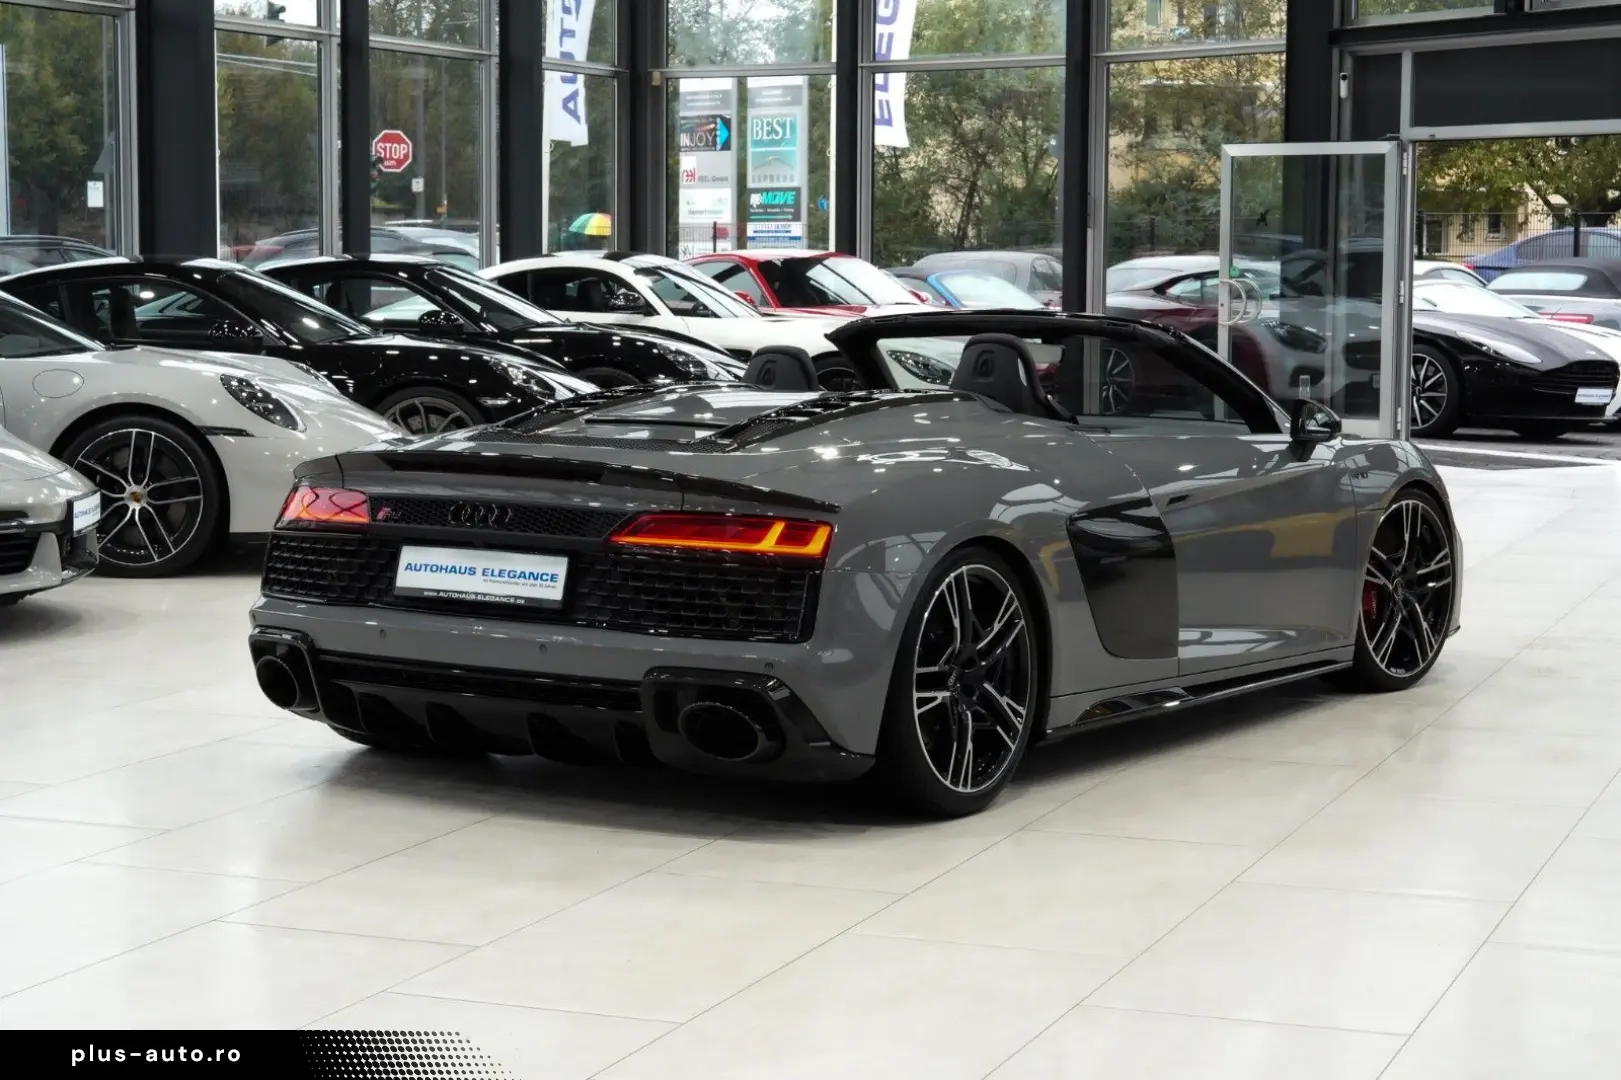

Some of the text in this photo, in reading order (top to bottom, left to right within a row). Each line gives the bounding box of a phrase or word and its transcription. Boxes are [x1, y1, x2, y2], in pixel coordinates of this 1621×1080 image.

[752, 117, 794, 140] BEST
[680, 131, 715, 147] INJOY
[376, 142, 408, 159] STOP
[404, 562, 477, 576] AUTOHAUS
[481, 567, 559, 583] ELEGANCE
